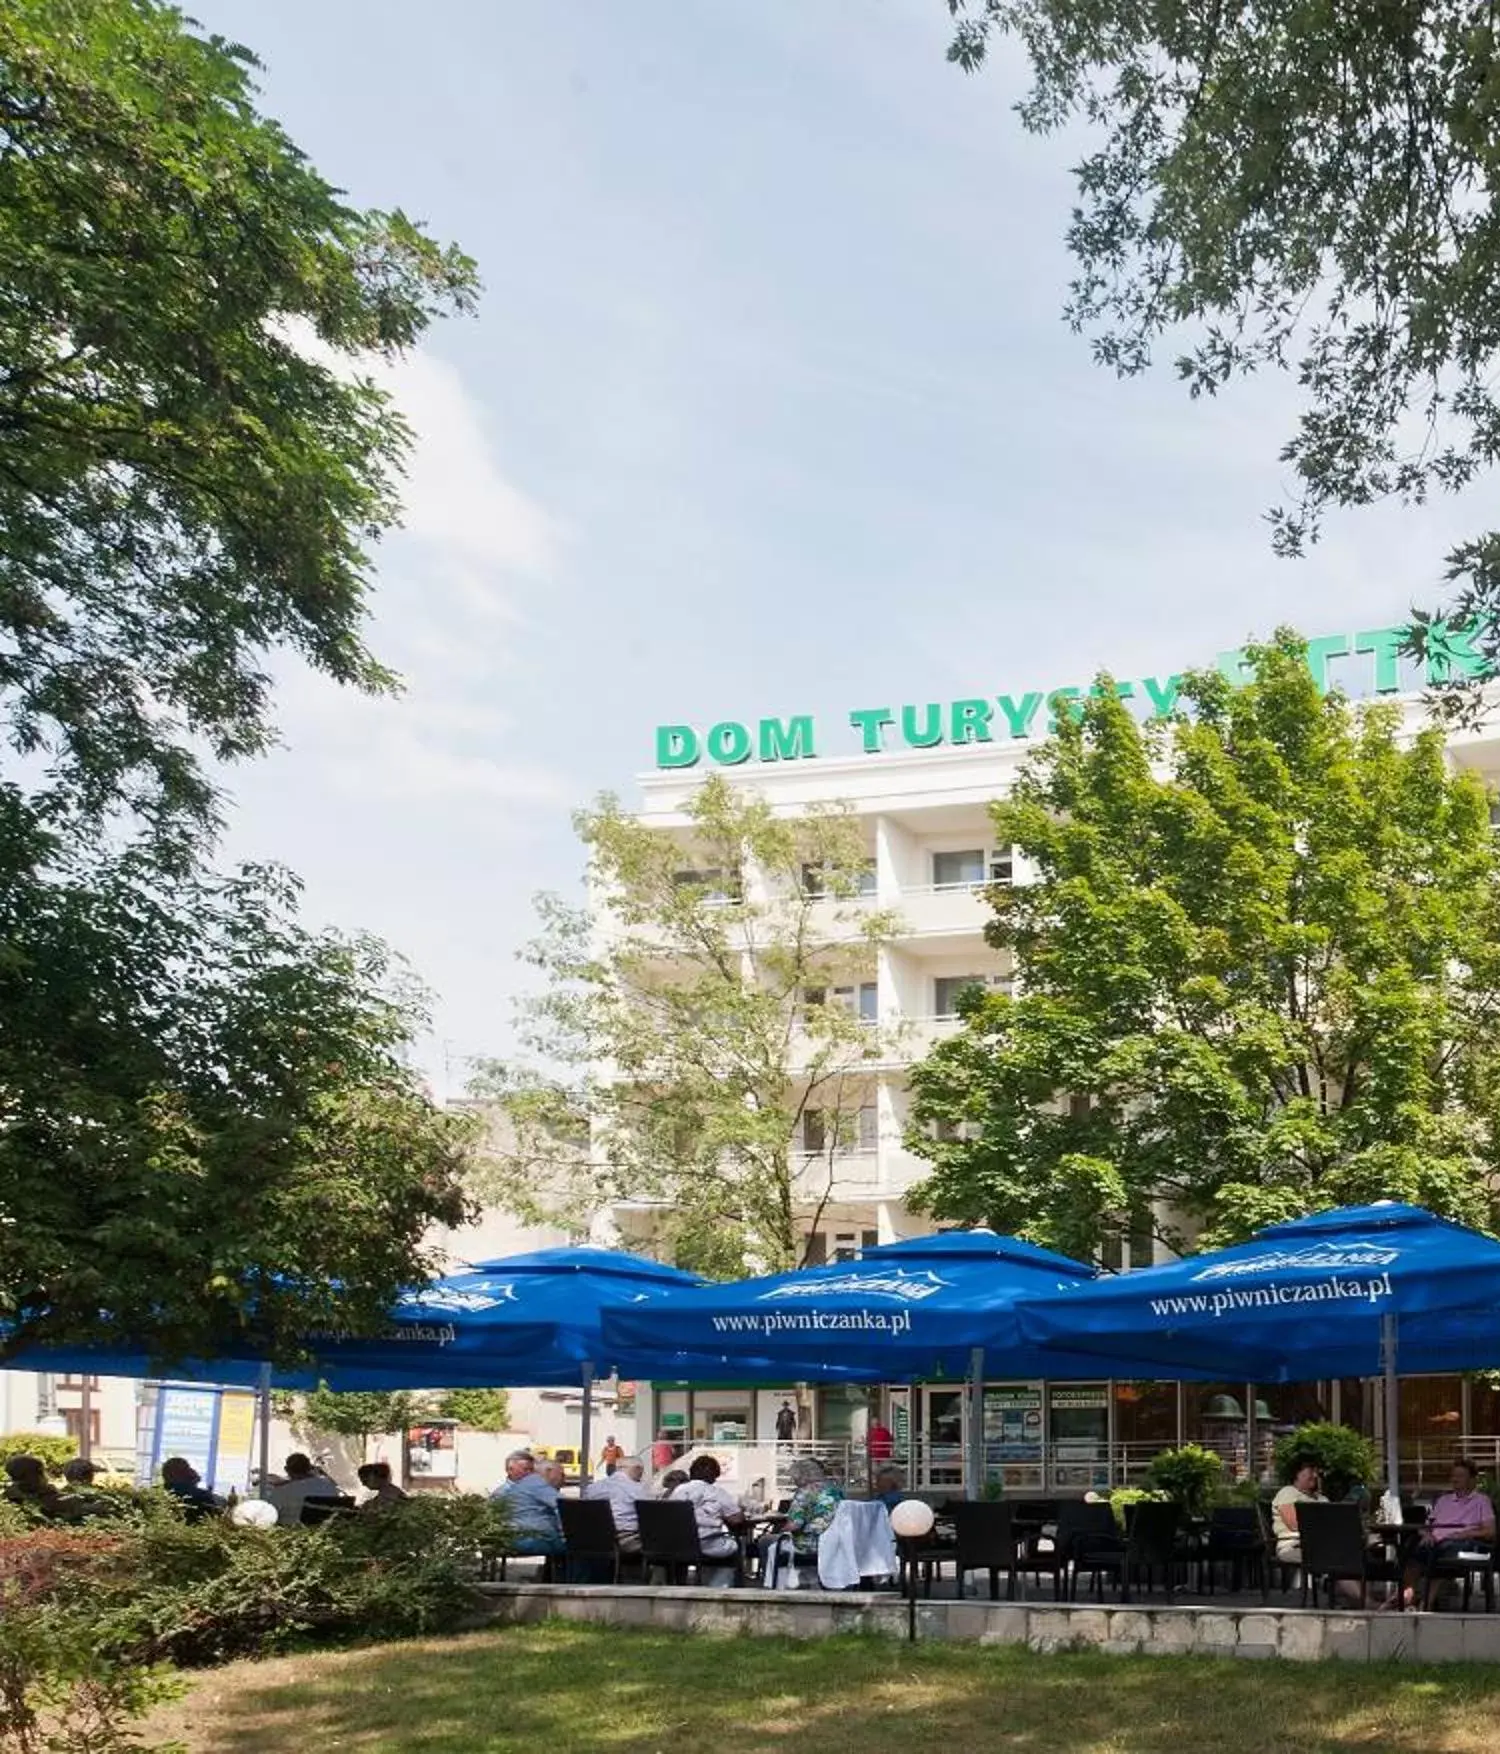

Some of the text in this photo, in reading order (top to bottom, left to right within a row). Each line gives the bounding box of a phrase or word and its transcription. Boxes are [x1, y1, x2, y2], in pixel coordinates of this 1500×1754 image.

[656, 714, 818, 769] DOM
[1151, 1272, 1393, 1316] www.piwniczanka.pl
[711, 1309, 912, 1336] www.piwniczanka.pl
